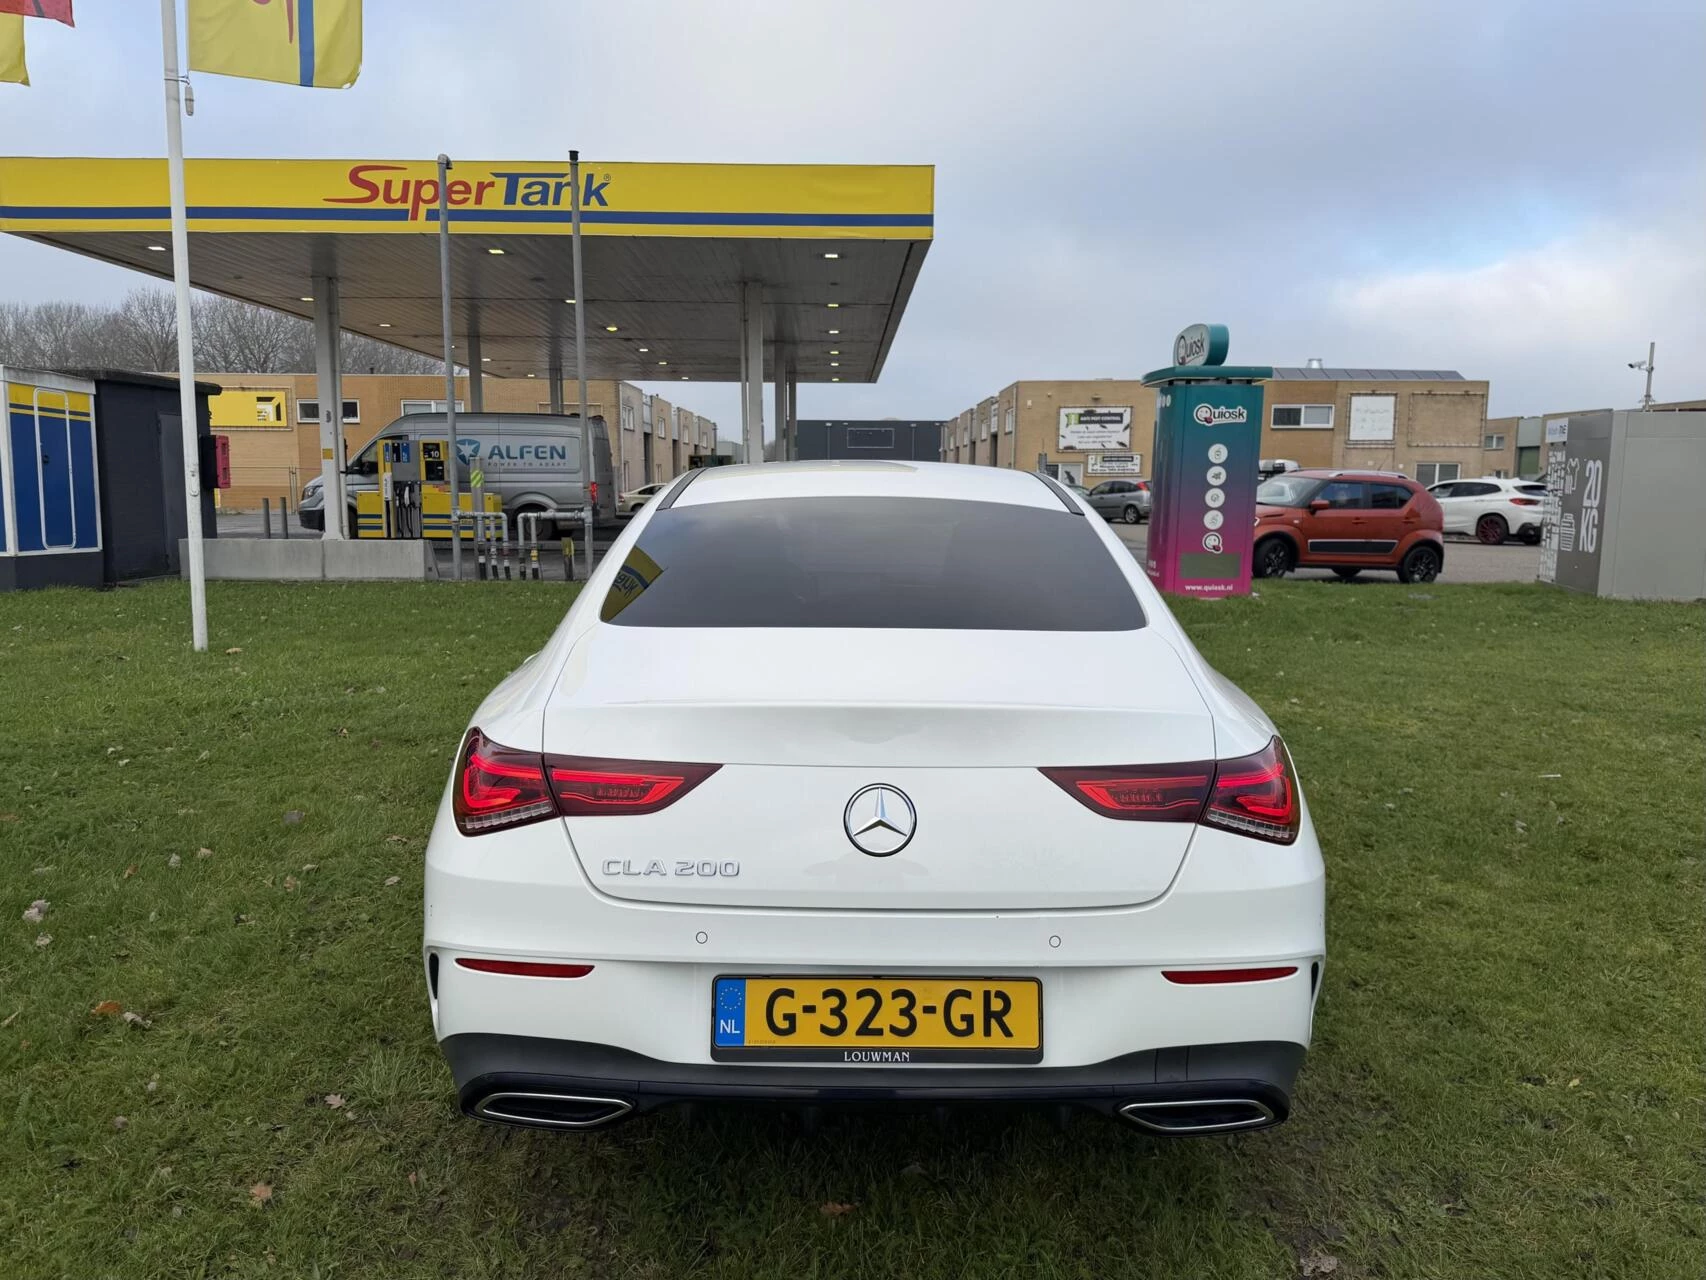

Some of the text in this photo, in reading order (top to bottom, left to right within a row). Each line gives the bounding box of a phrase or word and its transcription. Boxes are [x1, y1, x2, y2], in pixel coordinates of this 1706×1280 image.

[1176, 332, 1205, 365] Quiosk
[1196, 405, 1245, 424] Quiosk
[487, 445, 566, 460] ALFEN
[1582, 459, 1603, 508] 20
[1579, 508, 1599, 553] KG
[1184, 583, 1234, 592] www.quiosk.nl
[602, 859, 740, 877] CLA 200
[765, 988, 1014, 1038] G-323-GR
[719, 1019, 741, 1034] NL
[844, 1051, 910, 1062] LOUWMAN
